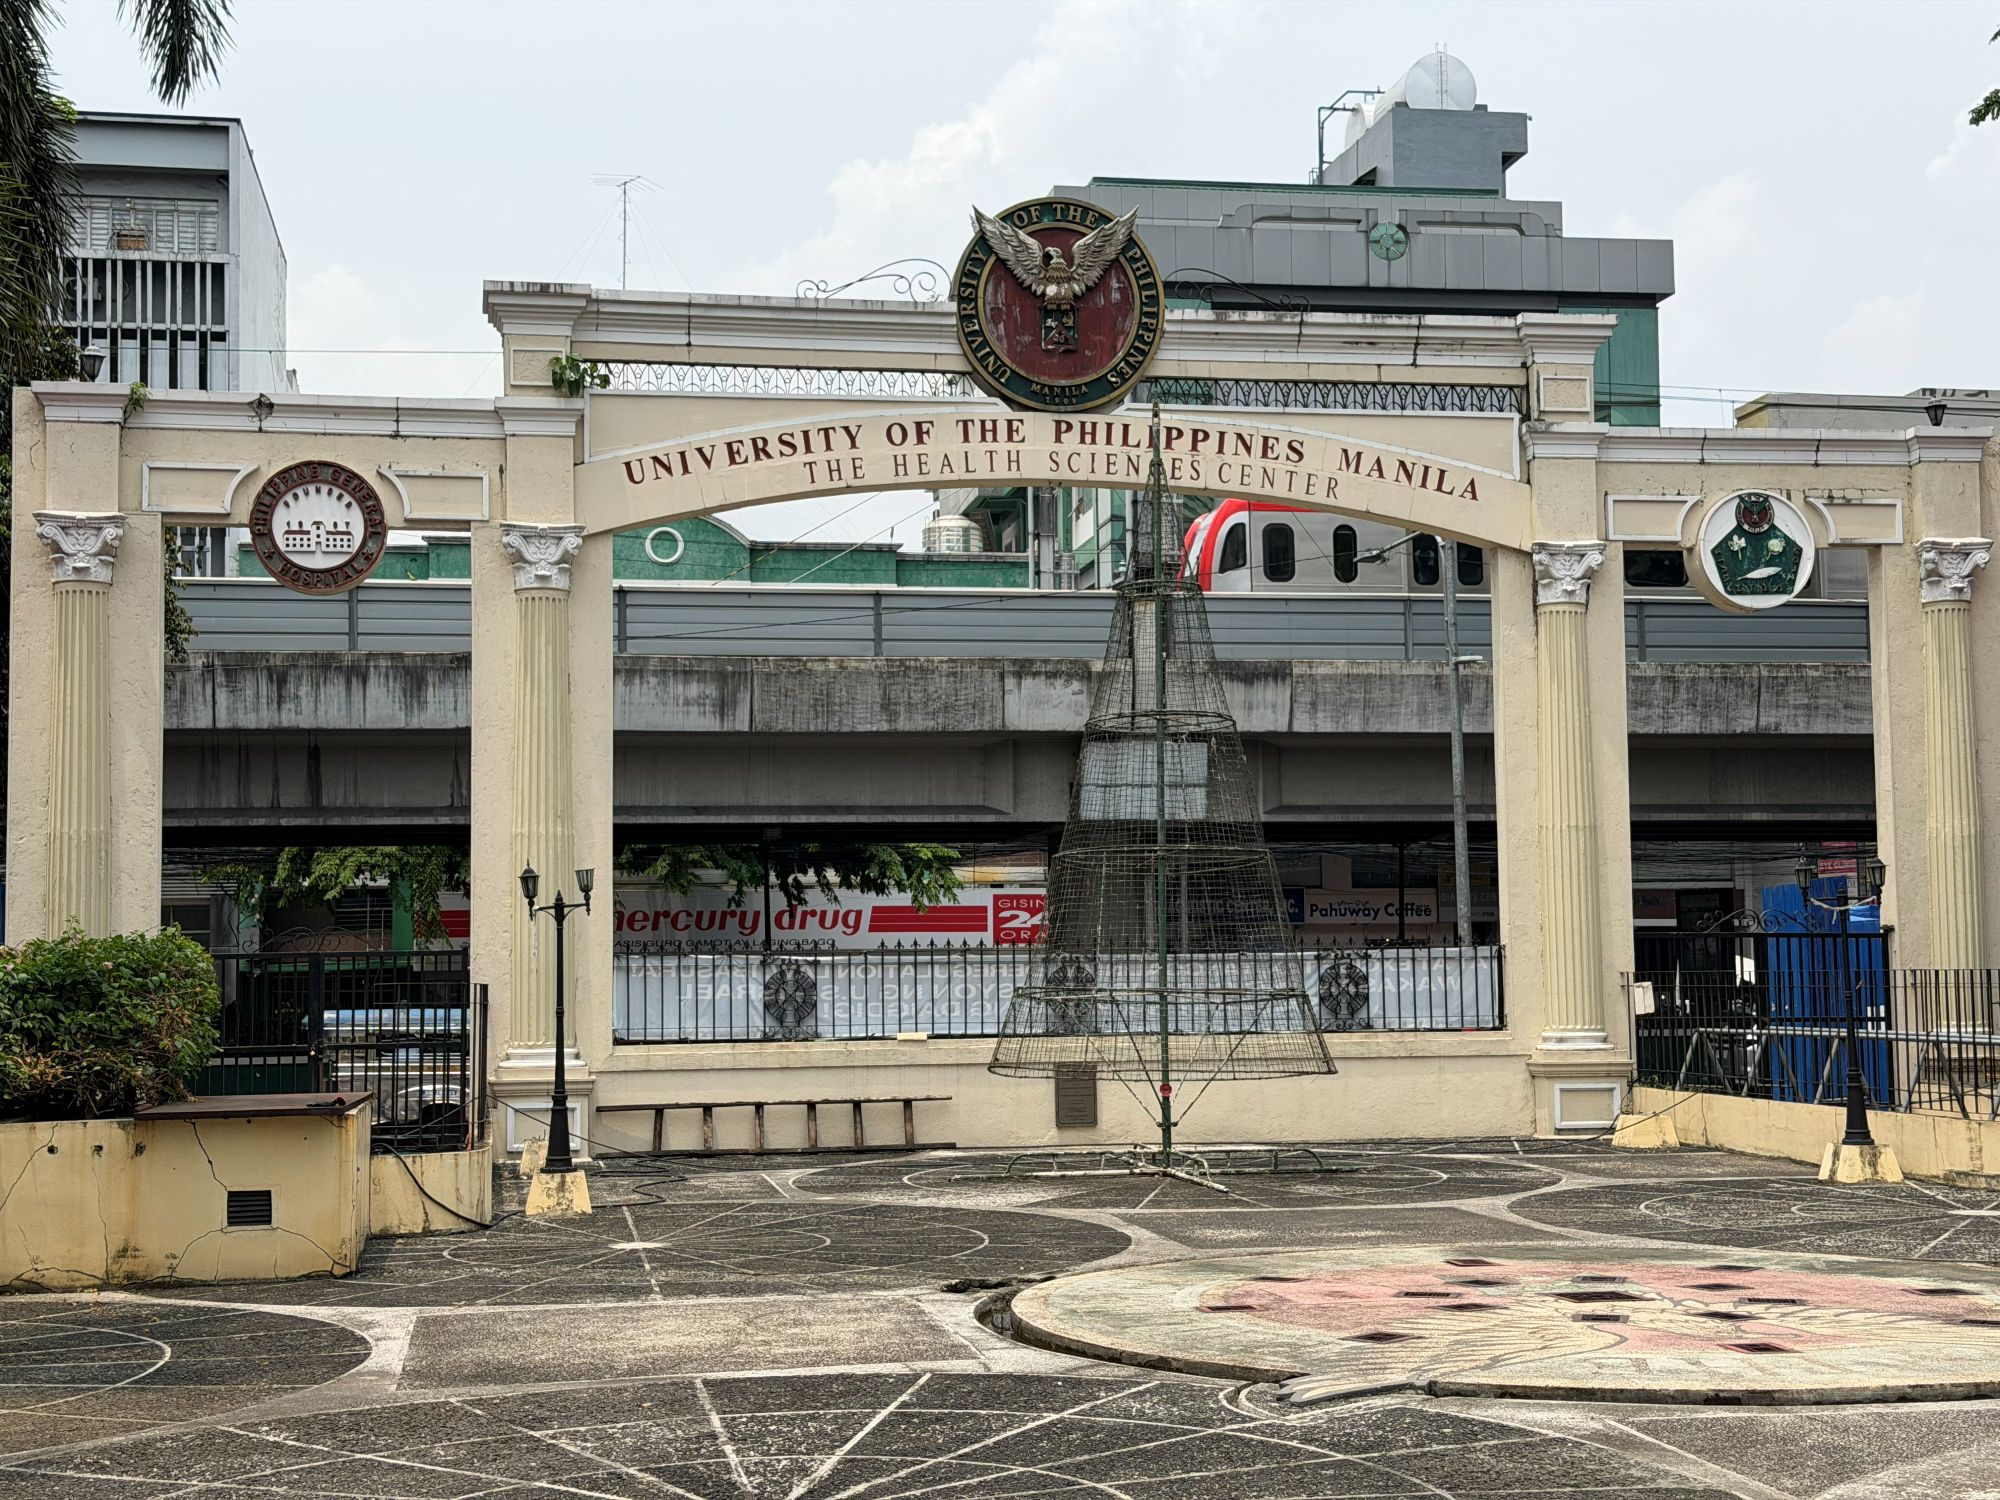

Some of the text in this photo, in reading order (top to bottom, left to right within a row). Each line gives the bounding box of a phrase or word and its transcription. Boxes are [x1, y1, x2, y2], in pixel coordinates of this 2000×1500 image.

[959, 203, 1158, 388] UNIVERSITY OF THE PHILIPPINES
[1030, 382, 1088, 396] MANILA
[622, 418, 1480, 502] UNIVERSITY OF THE PHILIPPINES MANILA
[803, 449, 1340, 501] THE HEALTH SCIENES CENTER
[254, 464, 383, 537] PHILIPPINE GENERAL
[277, 562, 365, 587] HOSPITAL
[774, 903, 863, 936] drug
[1309, 902, 1381, 921] Pahuway
